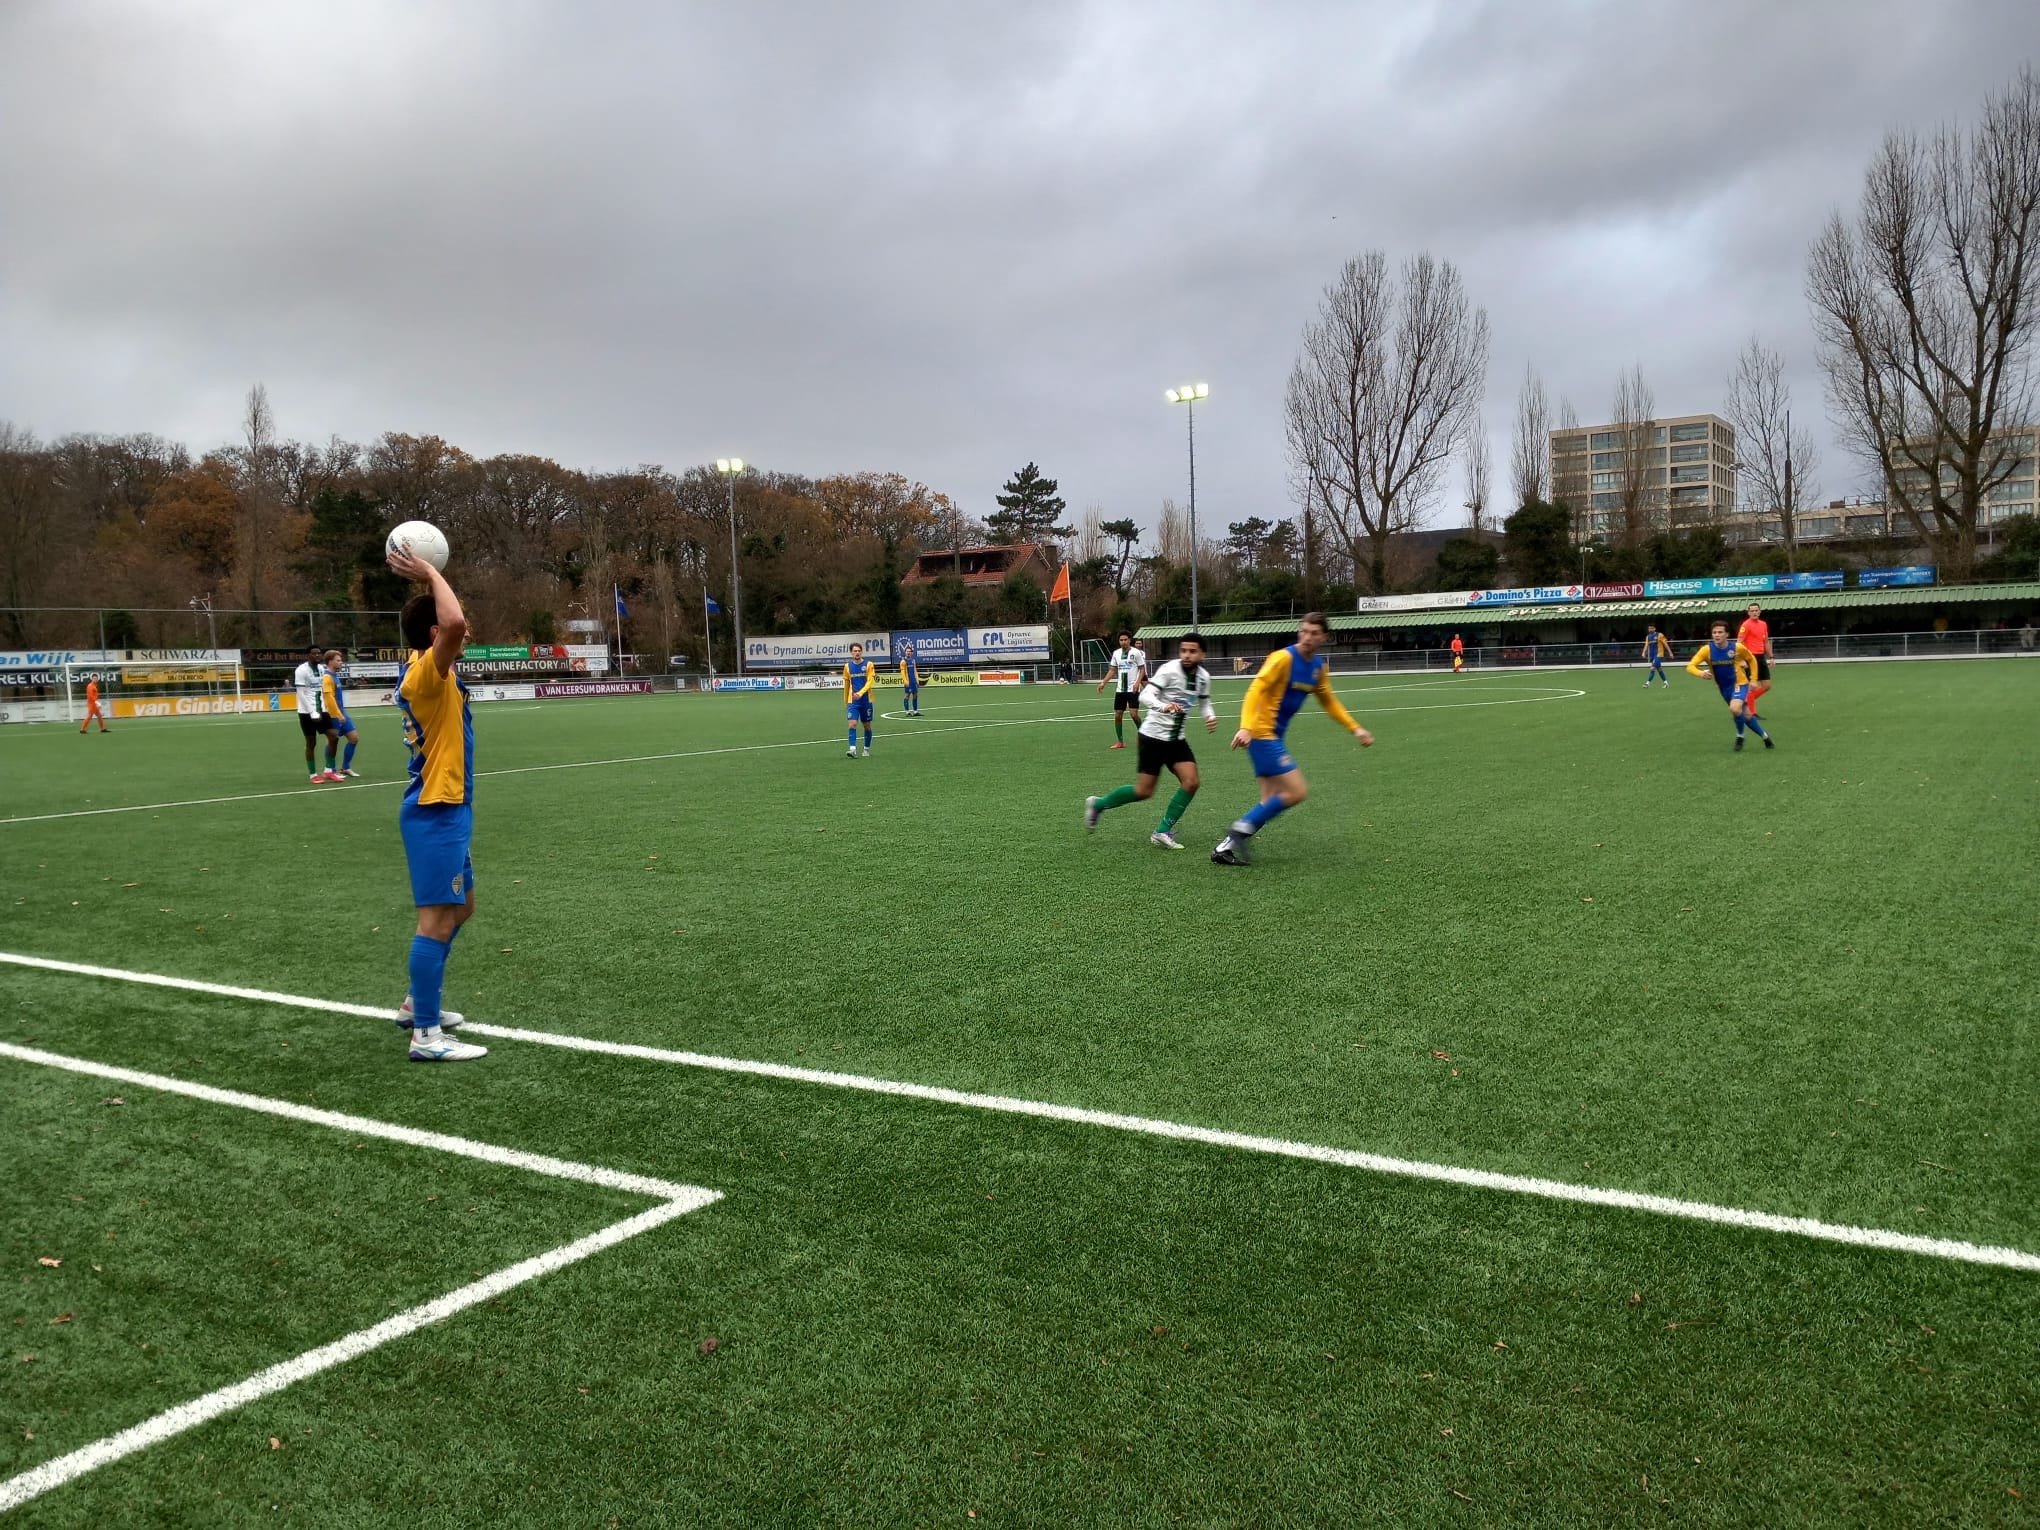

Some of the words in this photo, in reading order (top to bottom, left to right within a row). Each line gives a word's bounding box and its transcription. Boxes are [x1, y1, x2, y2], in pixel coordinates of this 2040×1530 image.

[1649, 581, 1703, 591] Hisense
[1712, 577, 1769, 588] Hisense
[1485, 588, 1531, 600] Domino's
[1533, 587, 1562, 598] Pizza
[916, 634, 965, 649] mamach
[982, 632, 1005, 646] FPL
[749, 643, 769, 656] FPL
[773, 645, 812, 657] Dynamic
[816, 643, 849, 657] Logisti
[865, 639, 886, 652] FPL
[26, 651, 75, 666] Wijk
[140, 650, 207, 660] SCHWARZ
[455, 660, 569, 673] THEONLINEFACTORY.nl
[723, 678, 751, 687] Domino's
[752, 677, 769, 687] Pizza
[940, 672, 975, 685] bakertilly
[133, 700, 170, 717] van
[175, 696, 264, 716] Ginderen
